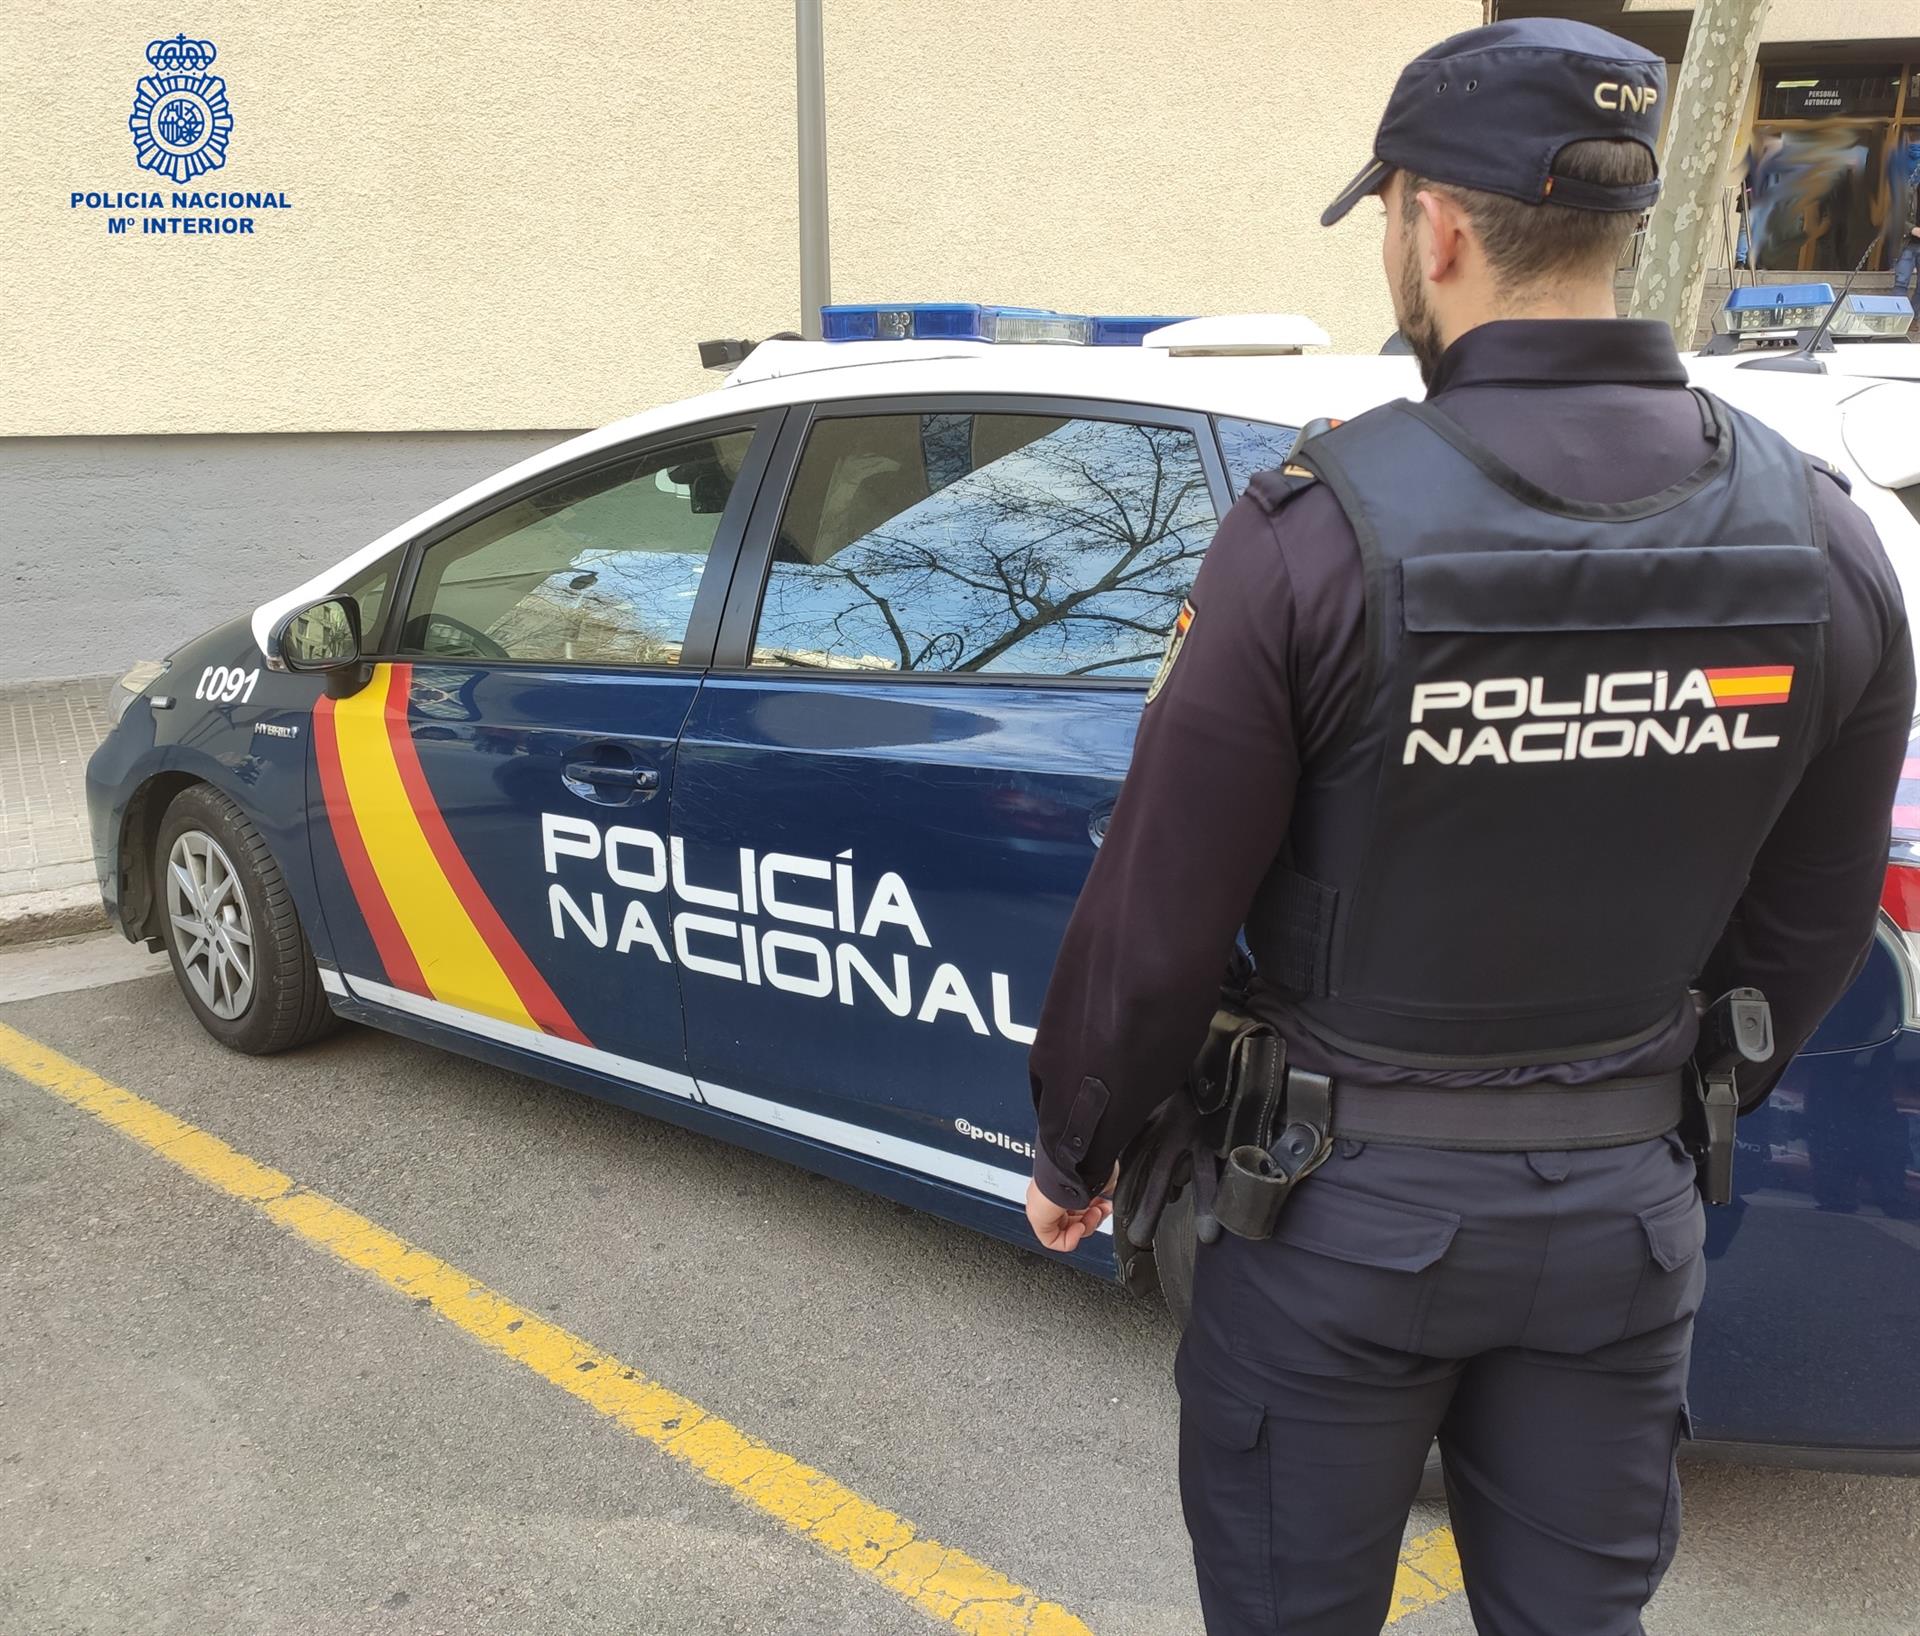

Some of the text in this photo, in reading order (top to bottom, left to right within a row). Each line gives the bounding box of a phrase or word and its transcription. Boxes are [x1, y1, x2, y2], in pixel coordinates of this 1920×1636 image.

[1593, 81, 1658, 115] CNP
[1803, 98, 1842, 106] AUTORIZADO
[1403, 713, 1780, 765] NACIONAL
[541, 812, 932, 947] POLICÍA
[548, 883, 1038, 1046] NACIONAL
